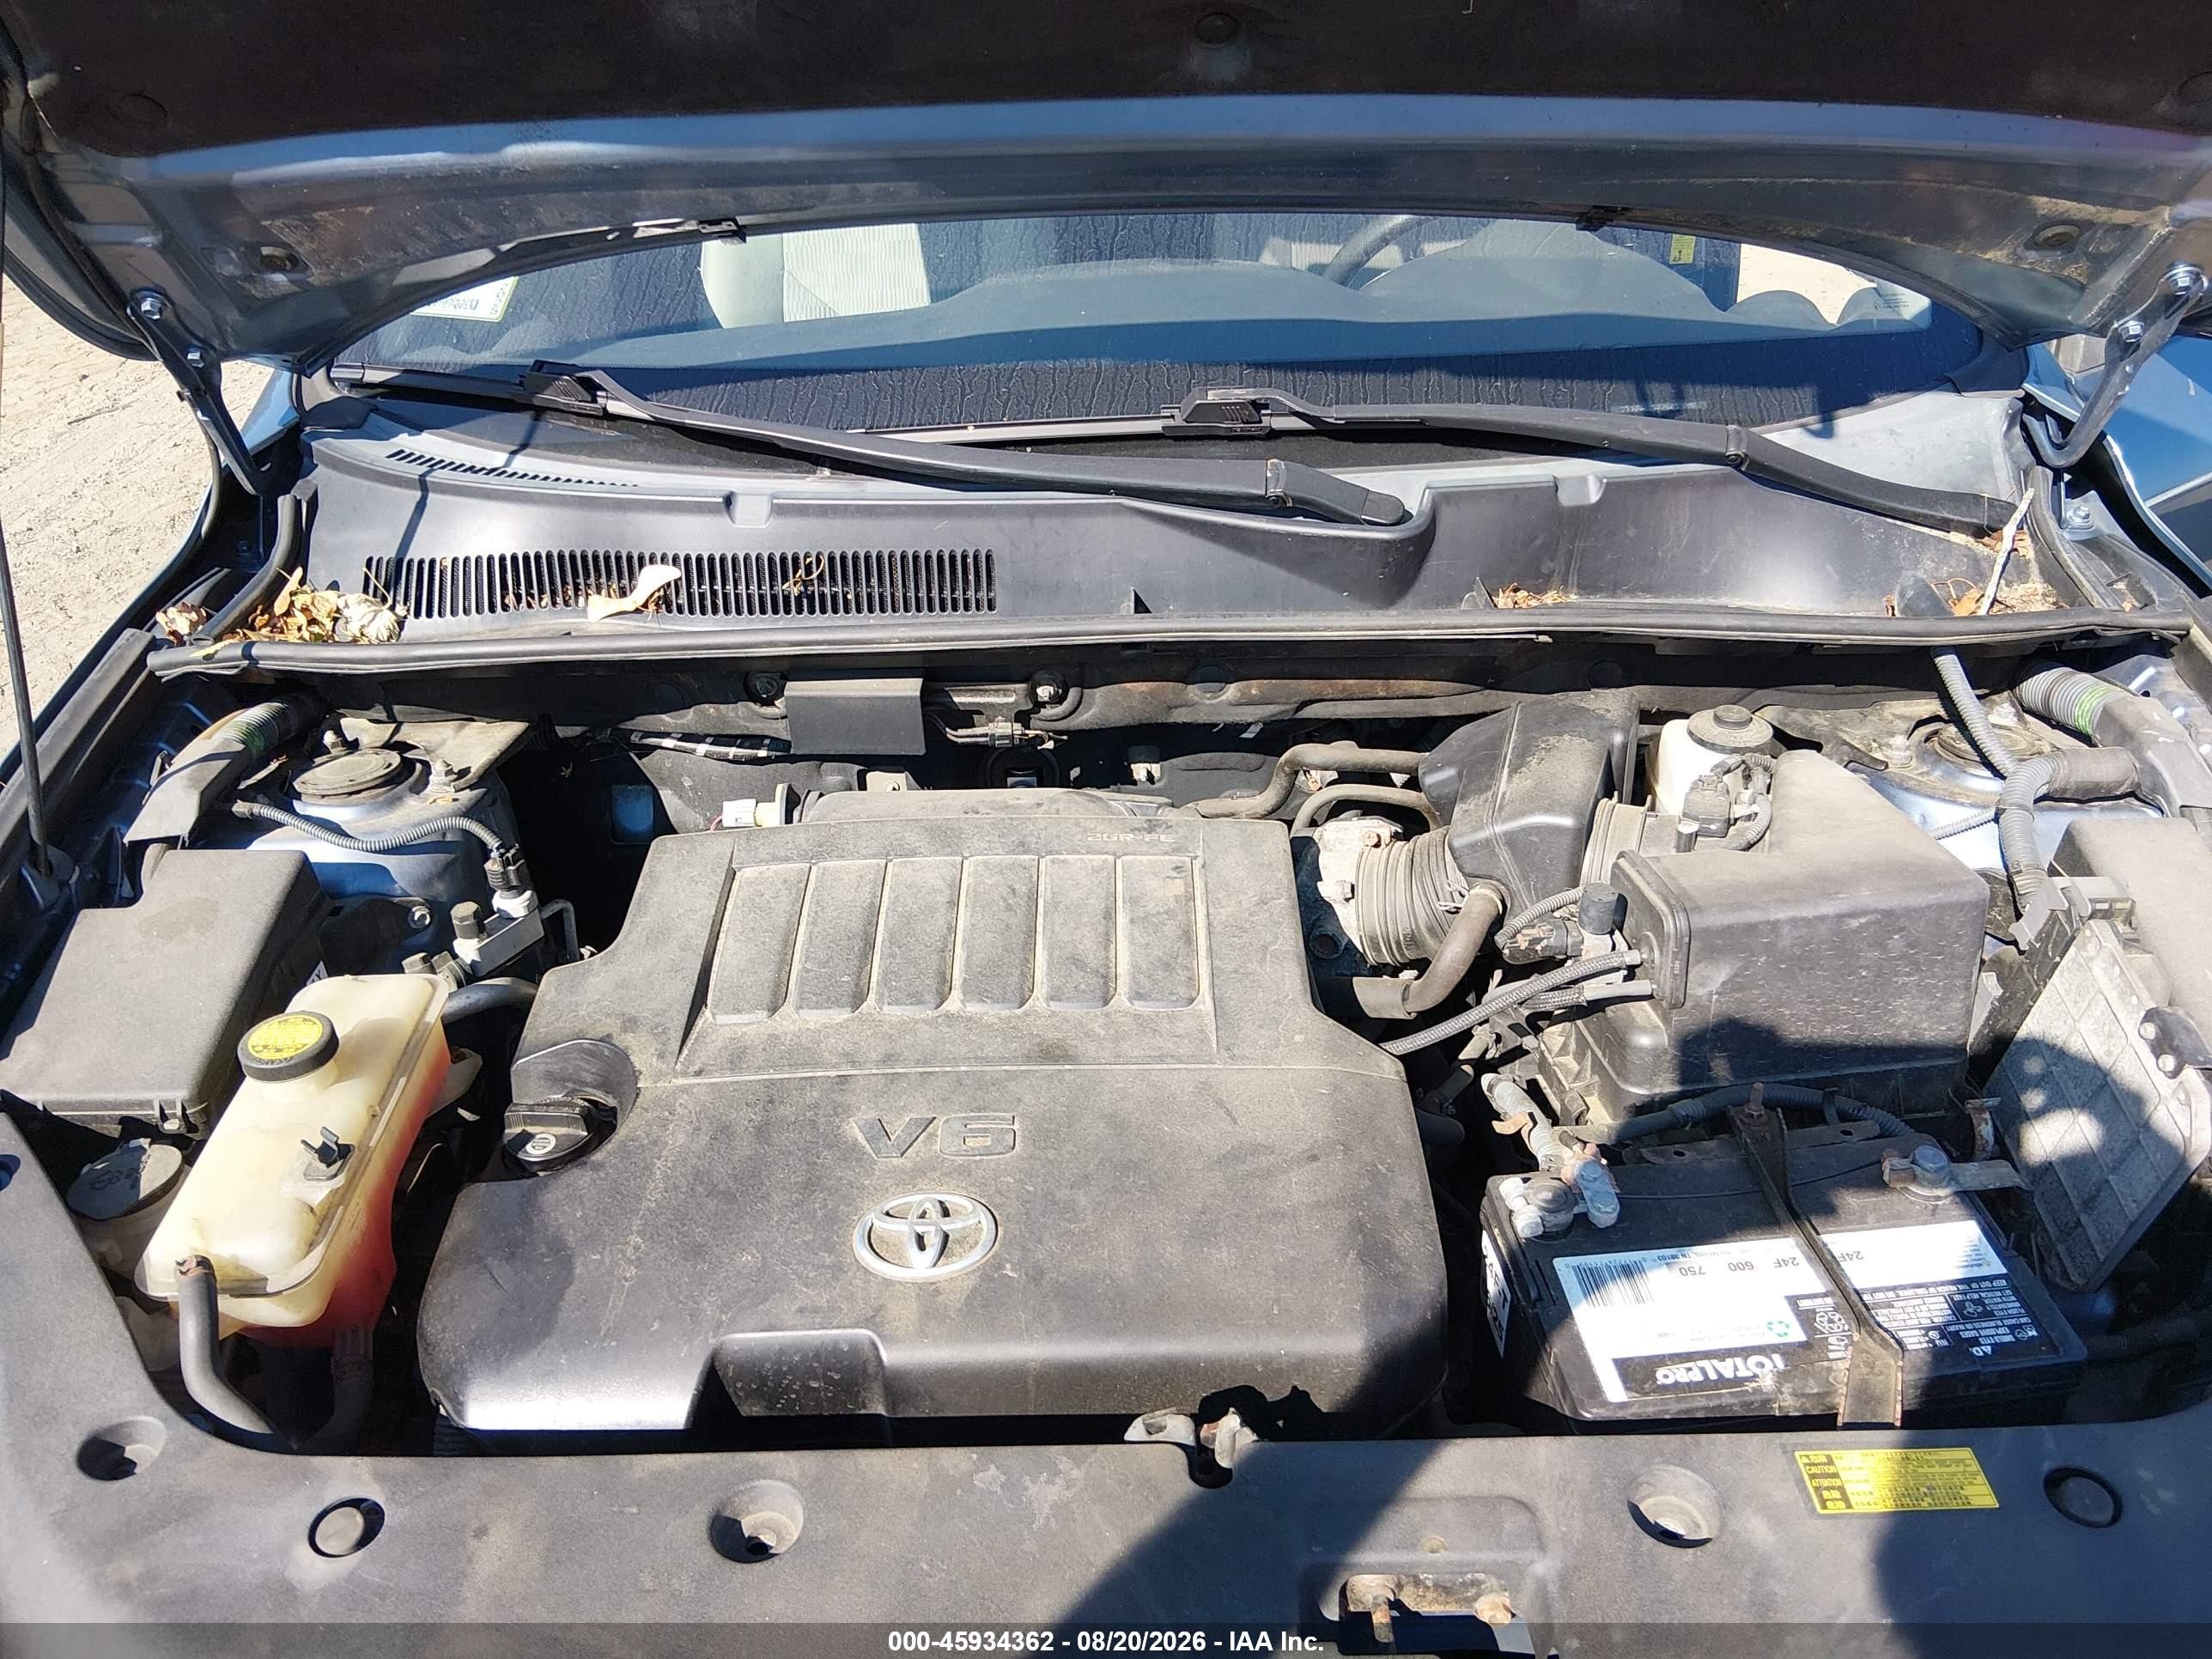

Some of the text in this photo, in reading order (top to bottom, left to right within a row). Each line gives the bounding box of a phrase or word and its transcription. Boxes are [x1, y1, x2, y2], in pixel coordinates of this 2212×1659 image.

[851, 1114, 1018, 1159] V6
[1837, 1250, 1863, 1262] 24F
[1678, 1257, 1799, 1277] 24F 600 750
[1985, 1302, 2021, 1310] IMMEDIATELY
[1973, 1319, 2002, 1328] BLINDNESS
[1960, 1327, 2009, 1339] EXPLOSIVE GASES
[1995, 1334, 2015, 1343] SHIELD
[1806, 1465, 1838, 1474] CAUTION
